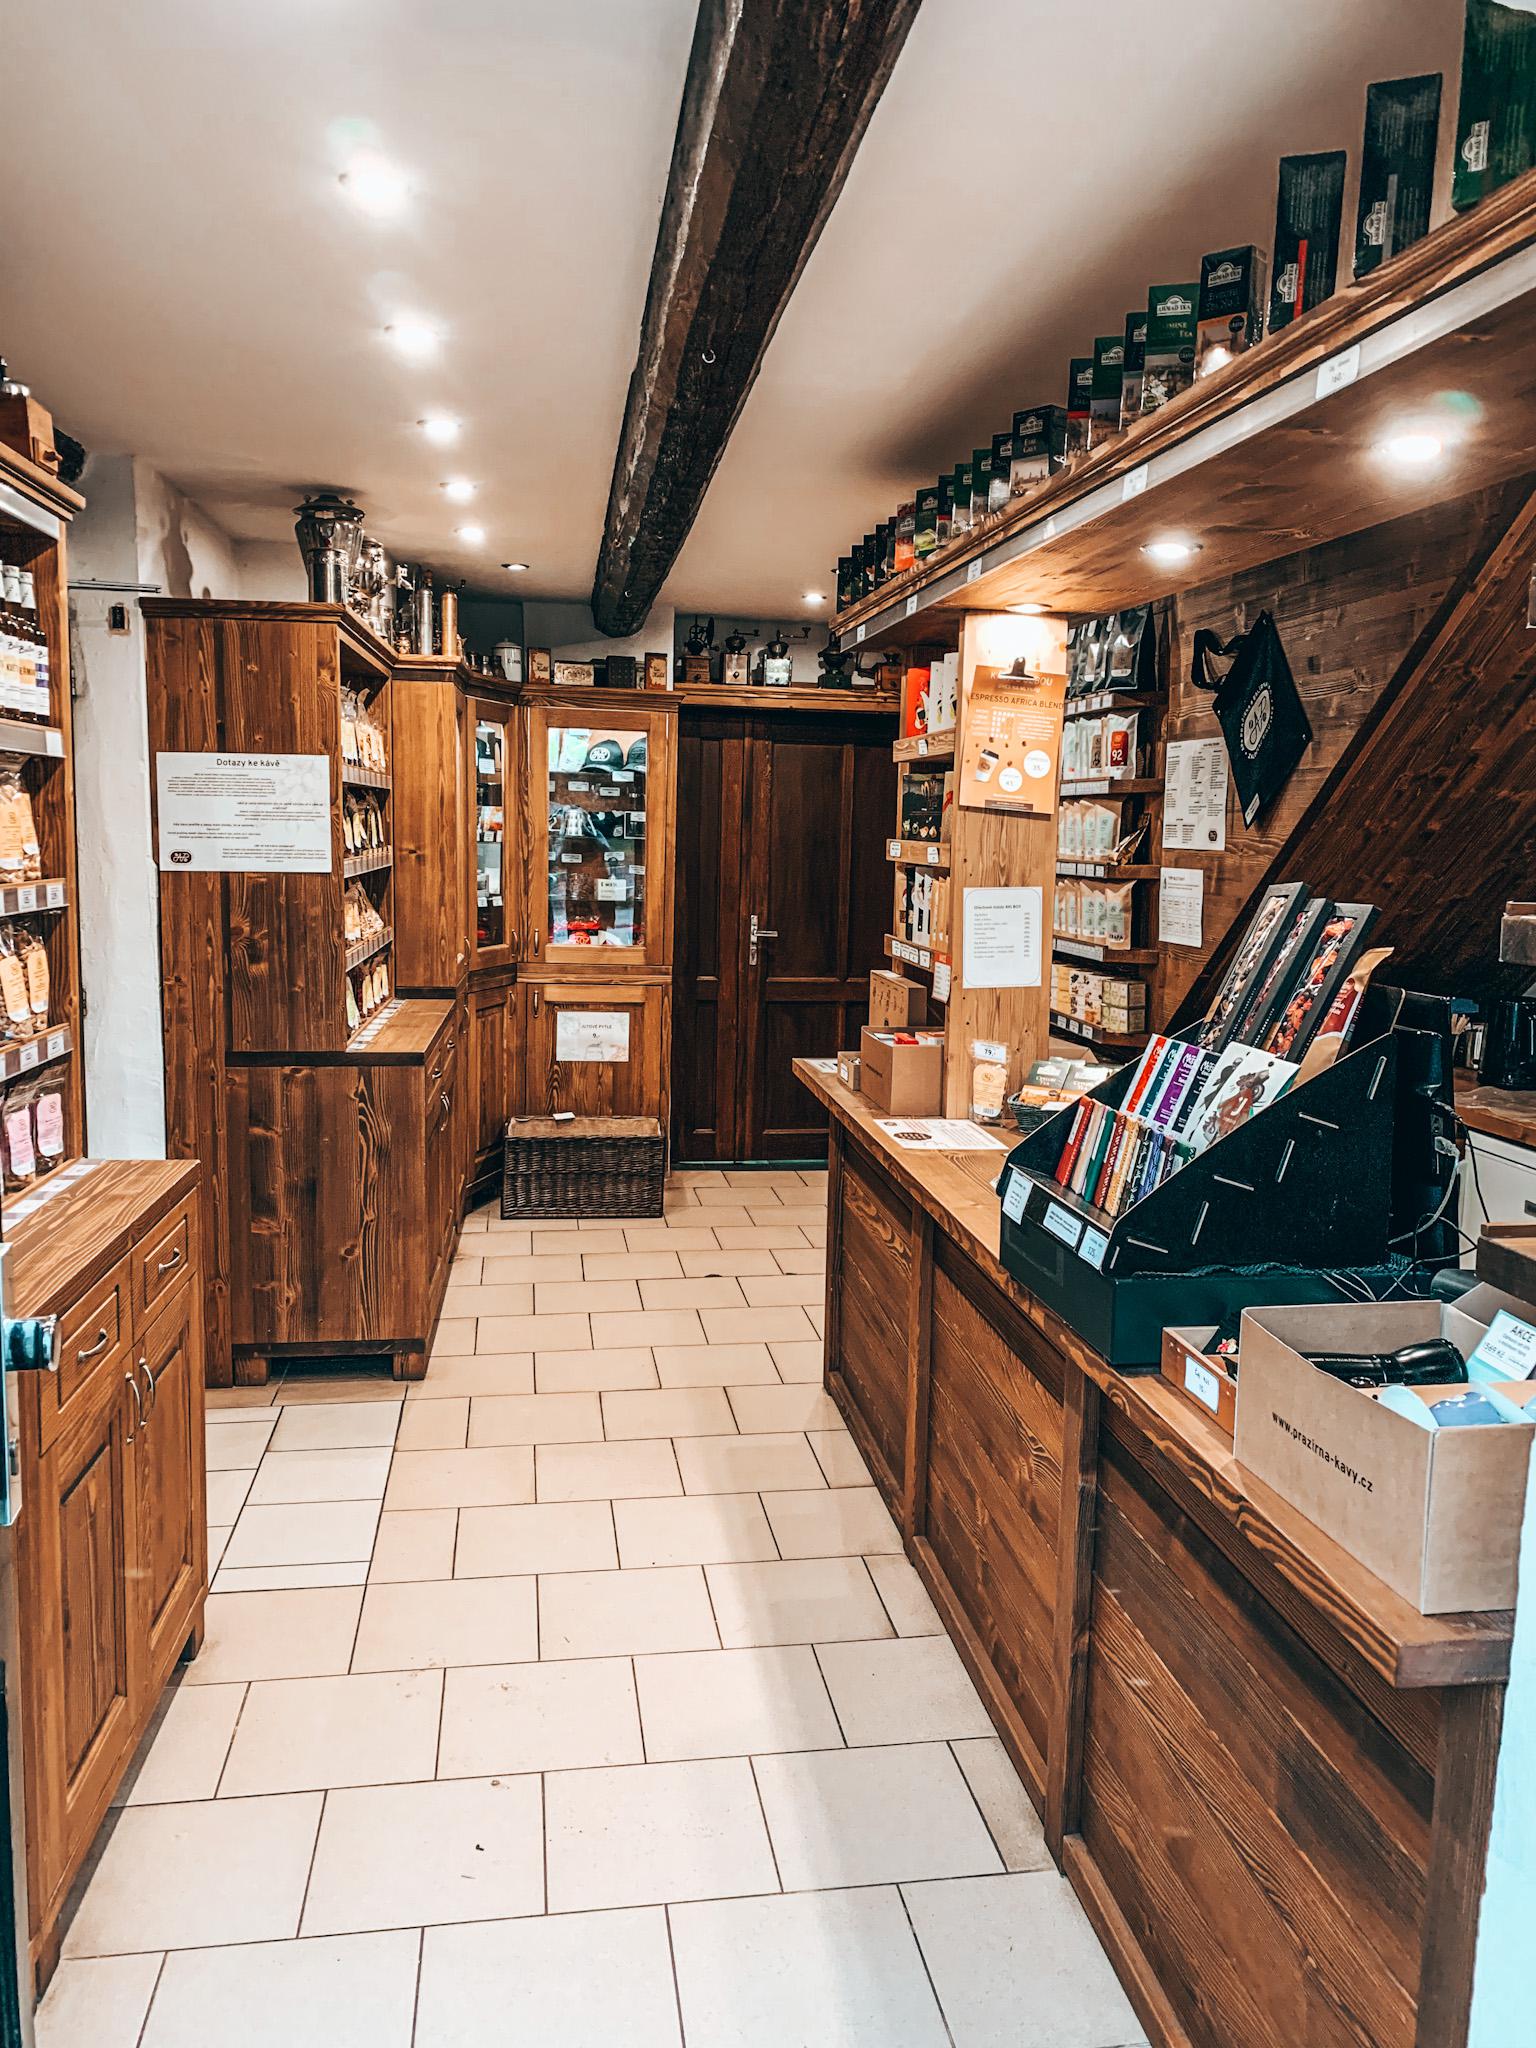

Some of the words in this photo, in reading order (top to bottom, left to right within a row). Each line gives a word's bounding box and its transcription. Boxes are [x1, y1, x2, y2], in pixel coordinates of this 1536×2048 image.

[1158, 304, 1179, 313] AHMAD
[970, 693, 1010, 704] ESPRESSO
[1010, 698, 1037, 707] AFRICA
[1039, 700, 1065, 710] BLEND
[1112, 749, 1123, 761] 92
[216, 758, 246, 768] Dotazy
[247, 759, 259, 767] ke
[260, 758, 281, 768] kávě
[1510, 1325, 1536, 1344] AKCE
[1272, 1412, 1373, 1492] www.prazirna-kavy.cz
